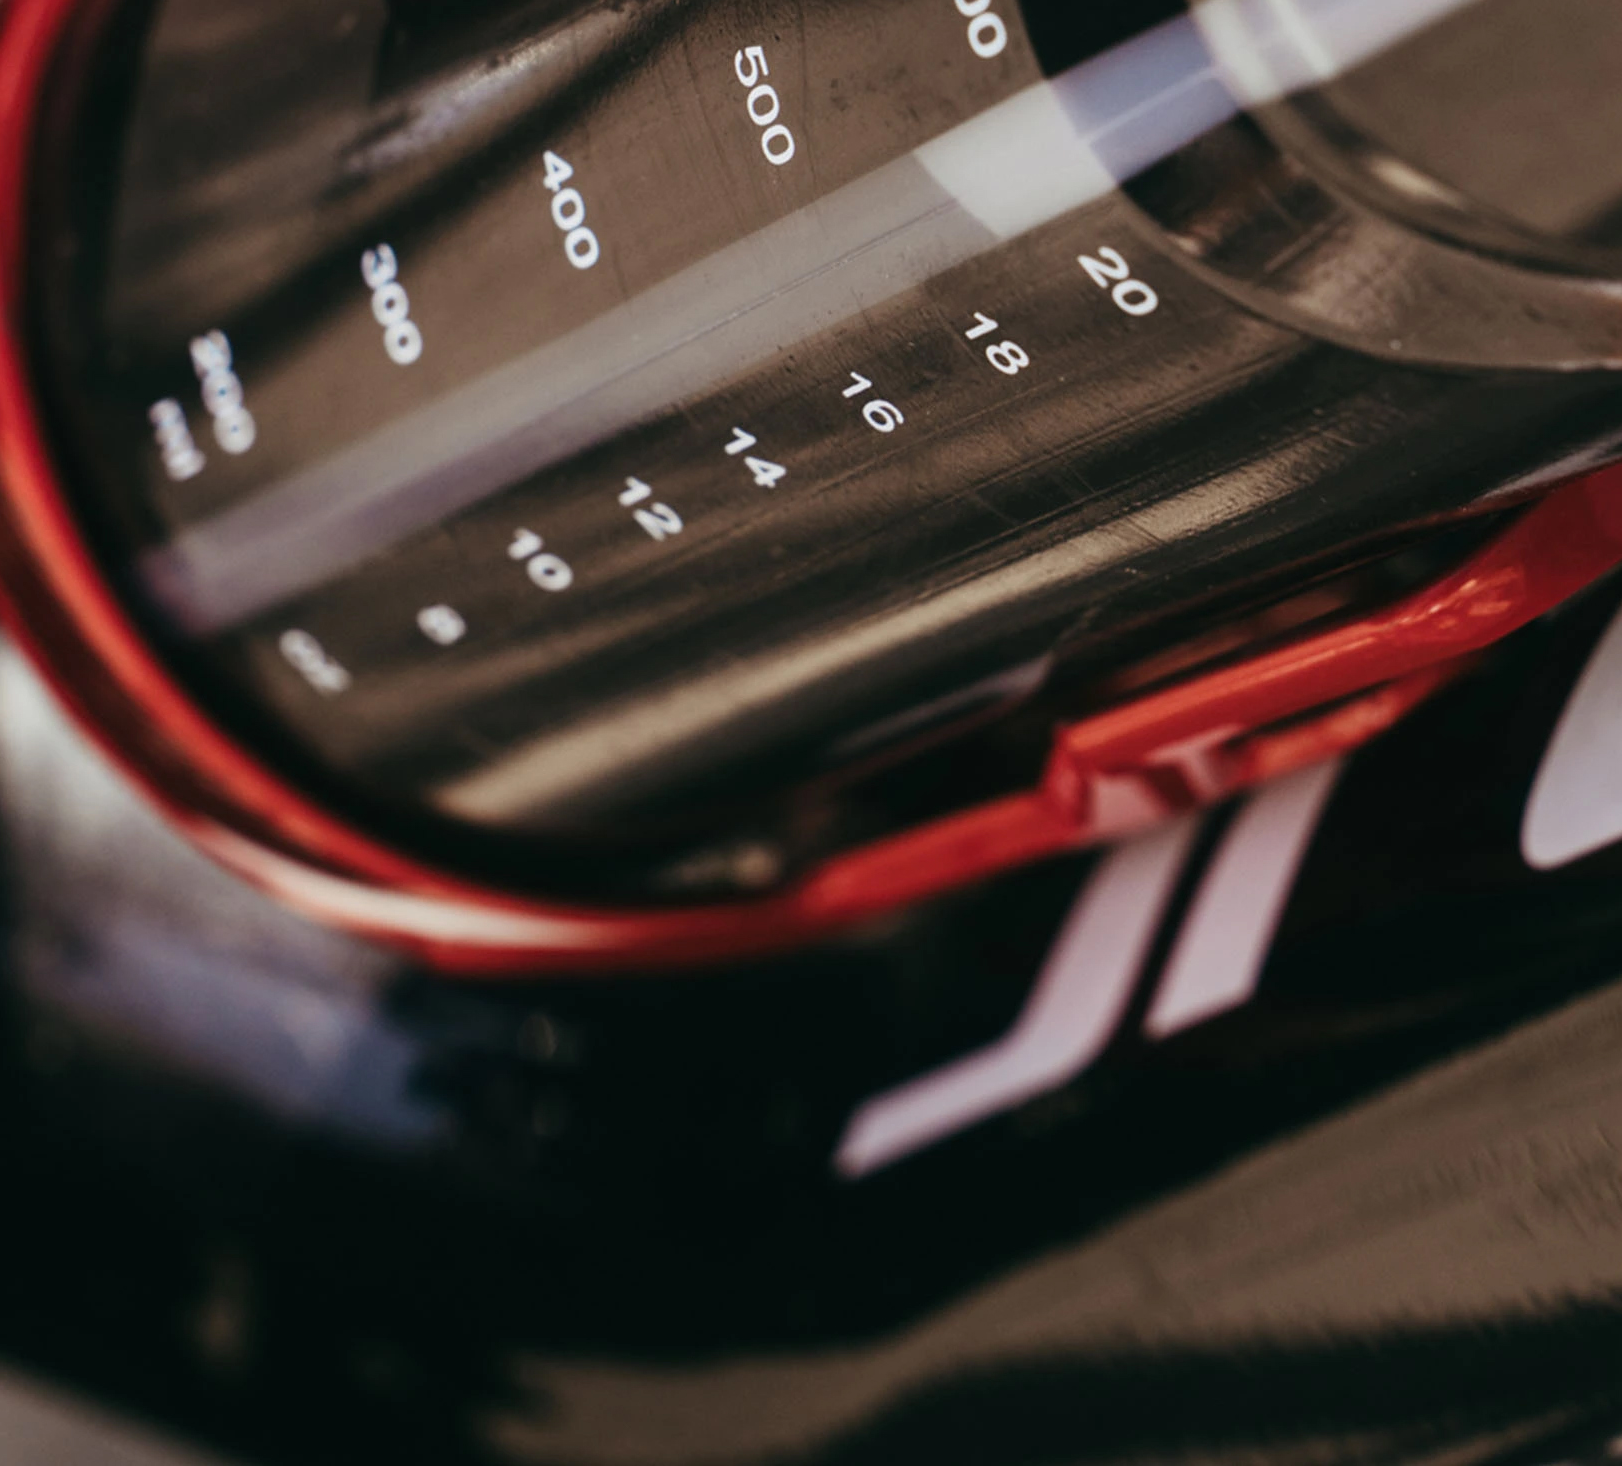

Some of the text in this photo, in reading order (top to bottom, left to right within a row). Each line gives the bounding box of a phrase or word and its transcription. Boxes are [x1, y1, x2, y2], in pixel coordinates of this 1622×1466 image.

[734, 46, 795, 166] 500
[542, 151, 600, 269] 400
[361, 244, 423, 365] 300
[1078, 245, 1158, 316] 20
[965, 311, 1029, 375] 18
[190, 331, 255, 455] 200
[842, 371, 904, 433] 16
[724, 427, 786, 488] 14
[618, 477, 682, 540] 12
[508, 529, 573, 591] 10
[416, 604, 466, 645] 8
